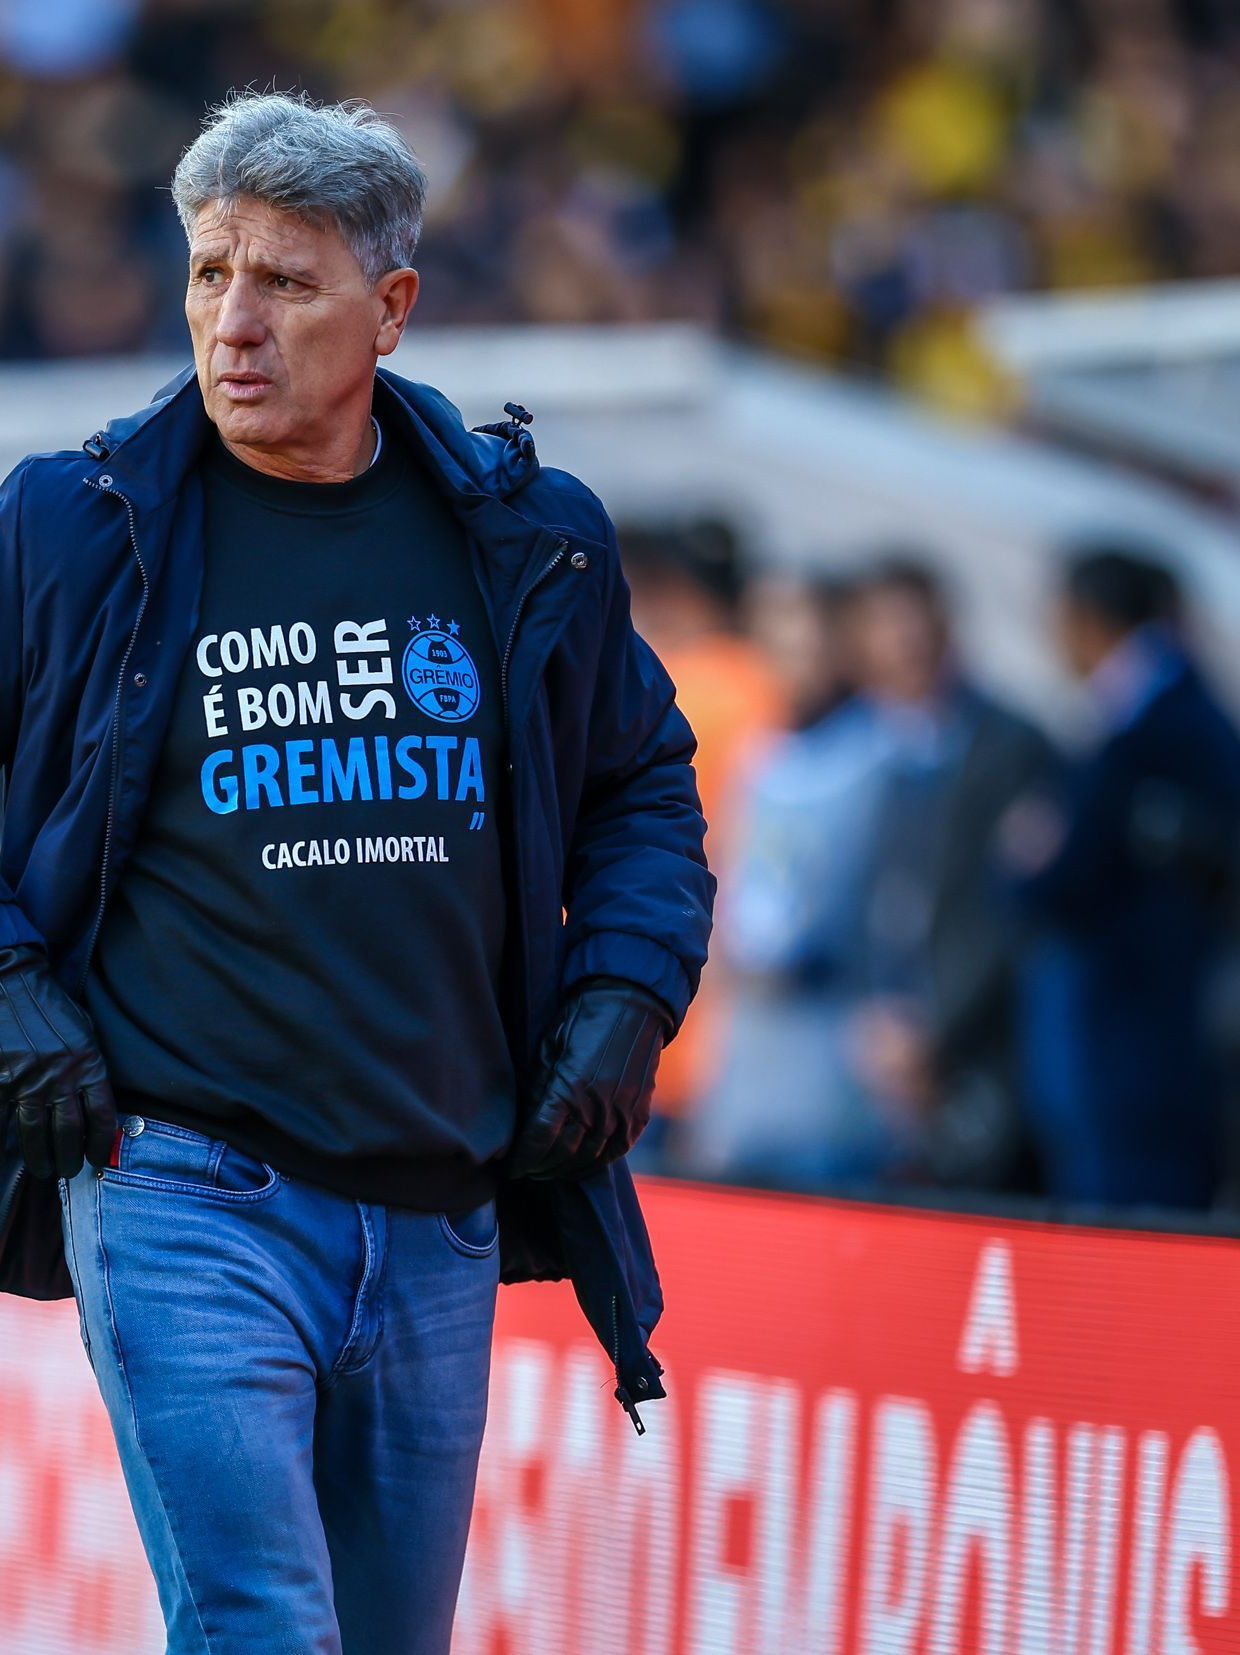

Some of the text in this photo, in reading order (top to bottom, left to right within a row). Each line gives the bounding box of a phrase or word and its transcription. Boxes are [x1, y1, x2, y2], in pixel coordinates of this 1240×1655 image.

[196, 621, 317, 678] COMO
[333, 618, 397, 720] SER
[409, 665, 474, 688] GRÊMIO
[202, 680, 334, 738] É BOM
[200, 735, 485, 815] GREMISTA
[261, 836, 450, 870] CACALO IMORTAL
